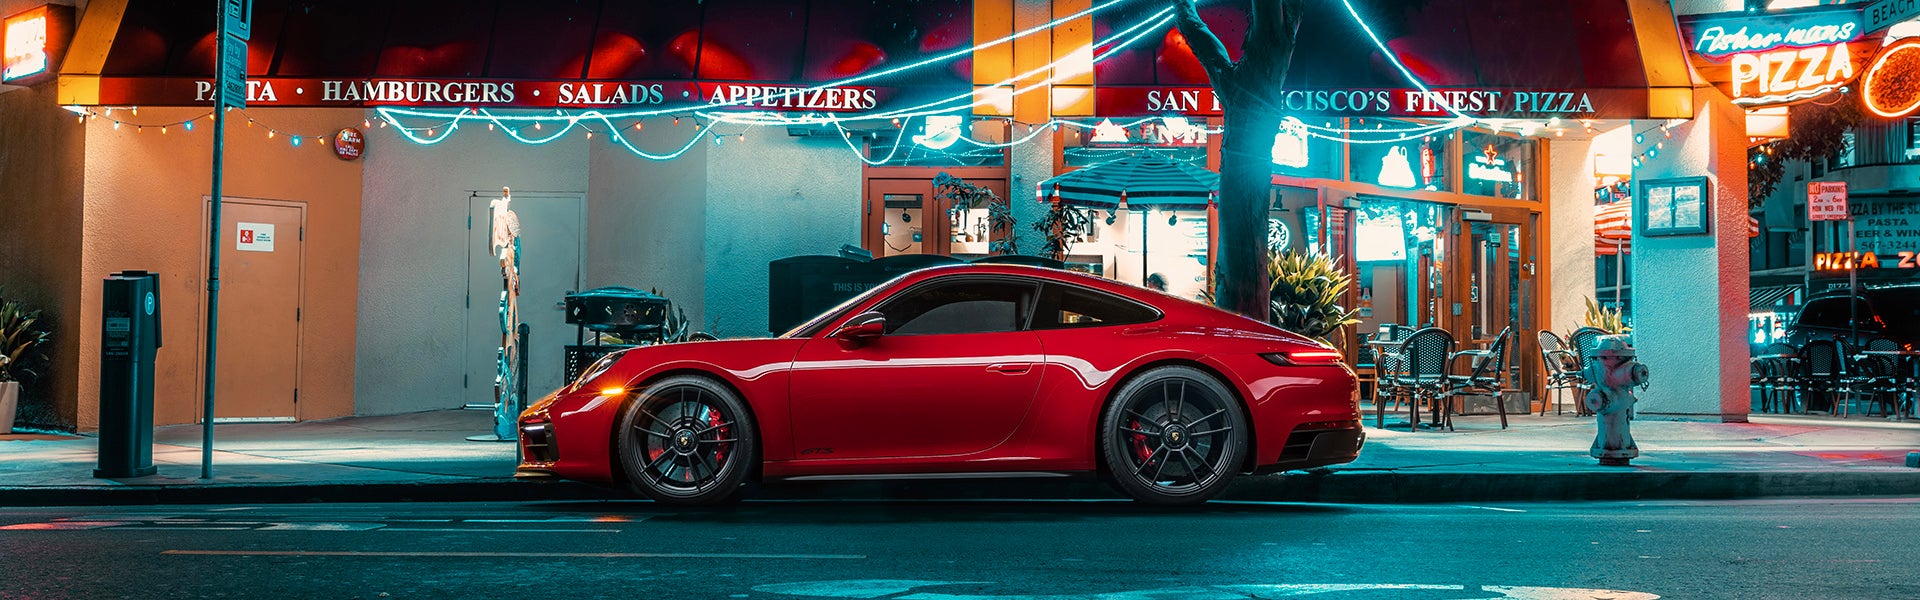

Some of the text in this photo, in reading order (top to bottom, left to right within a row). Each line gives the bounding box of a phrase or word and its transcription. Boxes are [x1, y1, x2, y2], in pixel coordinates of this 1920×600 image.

[1873, 0, 1914, 25] BEACH
[1731, 42, 1853, 97] PIZZA
[195, 81, 277, 101] PTA
[322, 80, 515, 103] HAMBURGERS
[558, 84, 664, 104] SALADS
[708, 84, 876, 110] APPETIZERS
[1147, 90, 1595, 113] SAN CISCO'S FINEST PIZZA
[1810, 184, 1820, 194] NO
[1872, 202, 1883, 215] BY
[1887, 201, 1905, 215] THE
[1868, 218, 1908, 226] PASTA
[1847, 230, 1880, 238] EER
[1884, 229, 1892, 237] &
[1816, 251, 1920, 270] PIZZA Z
[833, 283, 852, 291] THIS
[855, 283, 862, 291] IS
[800, 447, 834, 455] GTS
